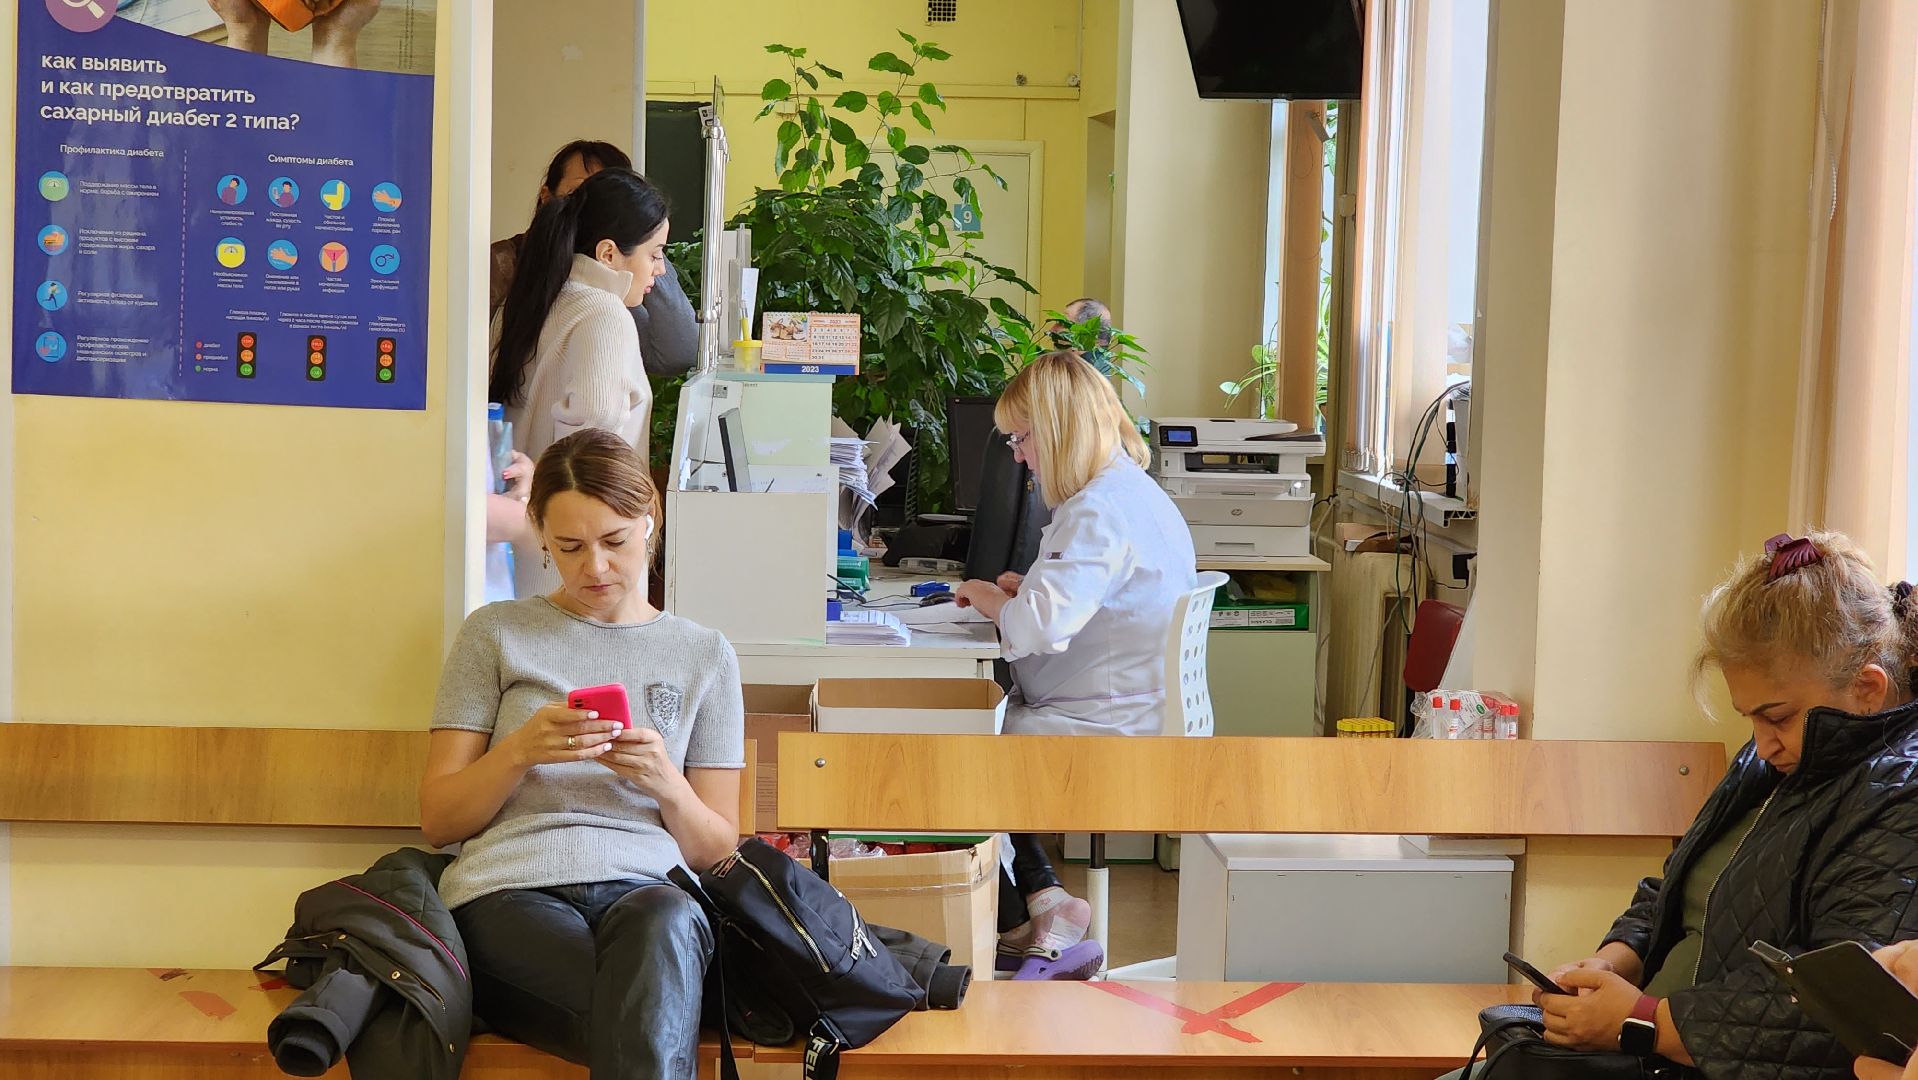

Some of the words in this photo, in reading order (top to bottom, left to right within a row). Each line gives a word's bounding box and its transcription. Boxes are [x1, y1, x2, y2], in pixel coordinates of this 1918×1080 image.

[41, 54, 76, 70] как
[81, 57, 167, 74] выявить
[41, 80, 54, 94] и
[59, 80, 94, 96] как
[99, 83, 256, 104] предотвратить
[40, 105, 141, 125] сахарный
[146, 109, 220, 127] диабет
[225, 113, 237, 128] 2
[242, 114, 300, 131] типа?
[60, 144, 125, 156] Профилактика
[126, 148, 164, 158] диабета
[268, 153, 315, 165] Симптомы
[316, 157, 354, 166] диабета
[963, 211, 972, 223] 9
[801, 365, 820, 373] 2023
